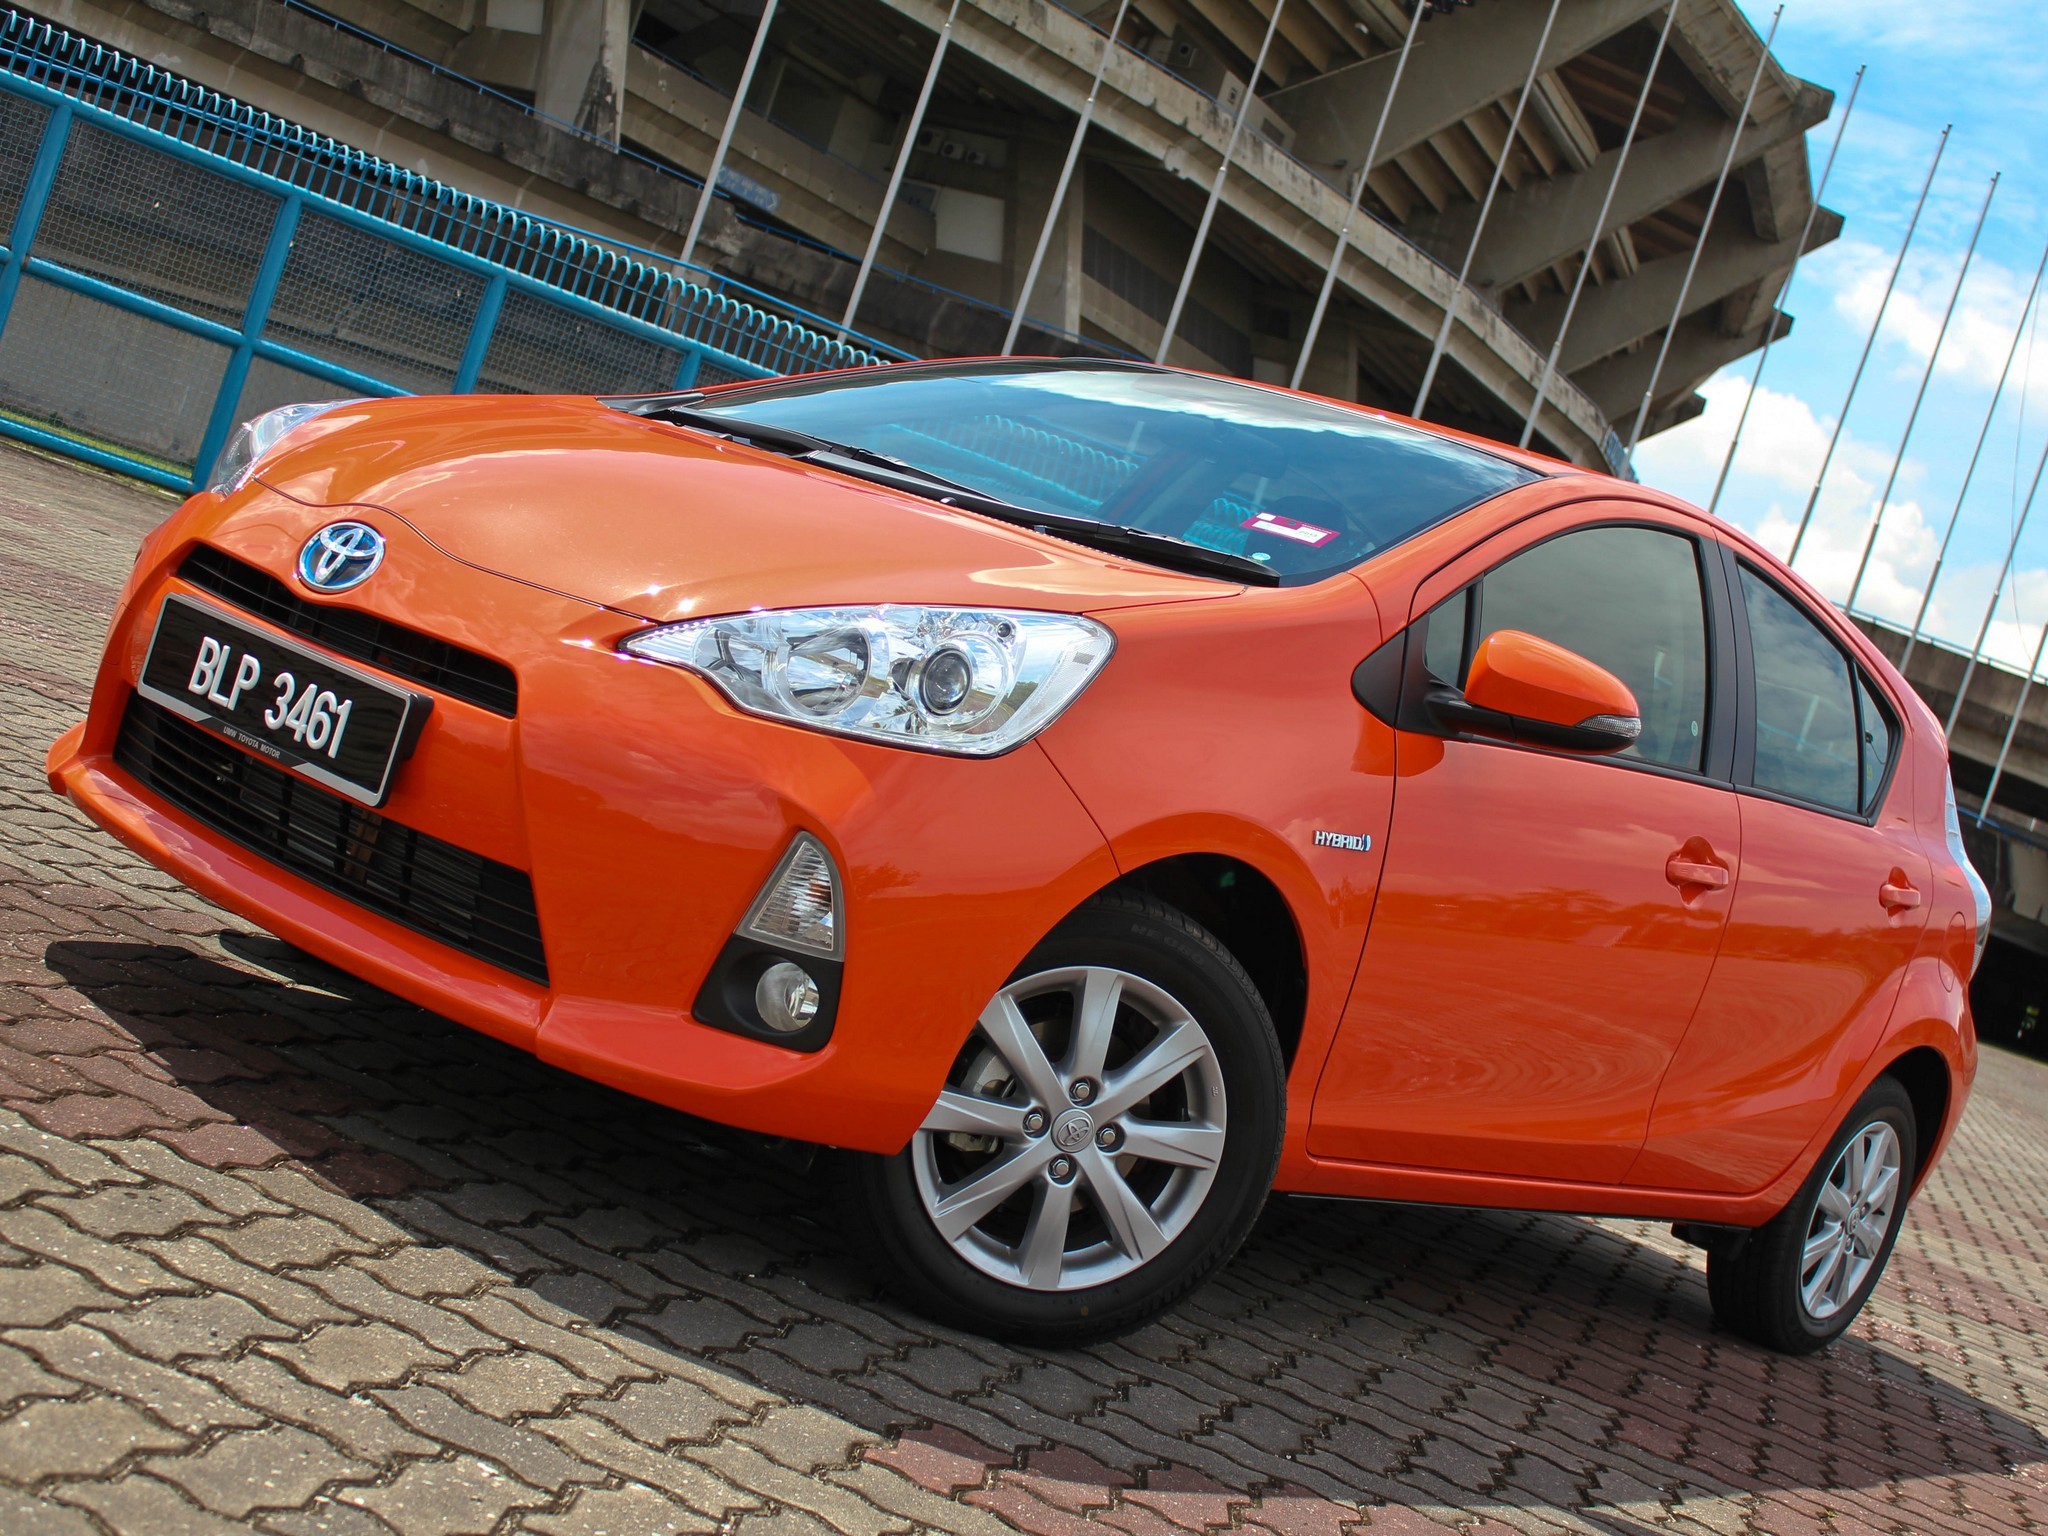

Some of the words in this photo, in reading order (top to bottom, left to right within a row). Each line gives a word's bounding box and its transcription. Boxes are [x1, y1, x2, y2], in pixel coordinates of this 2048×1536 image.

[187, 635, 261, 711] BLP
[264, 672, 353, 759] 3461
[238, 732, 260, 750] TOYOTA
[259, 743, 281, 759] MOTOR
[1314, 830, 1364, 851] HYBRID
